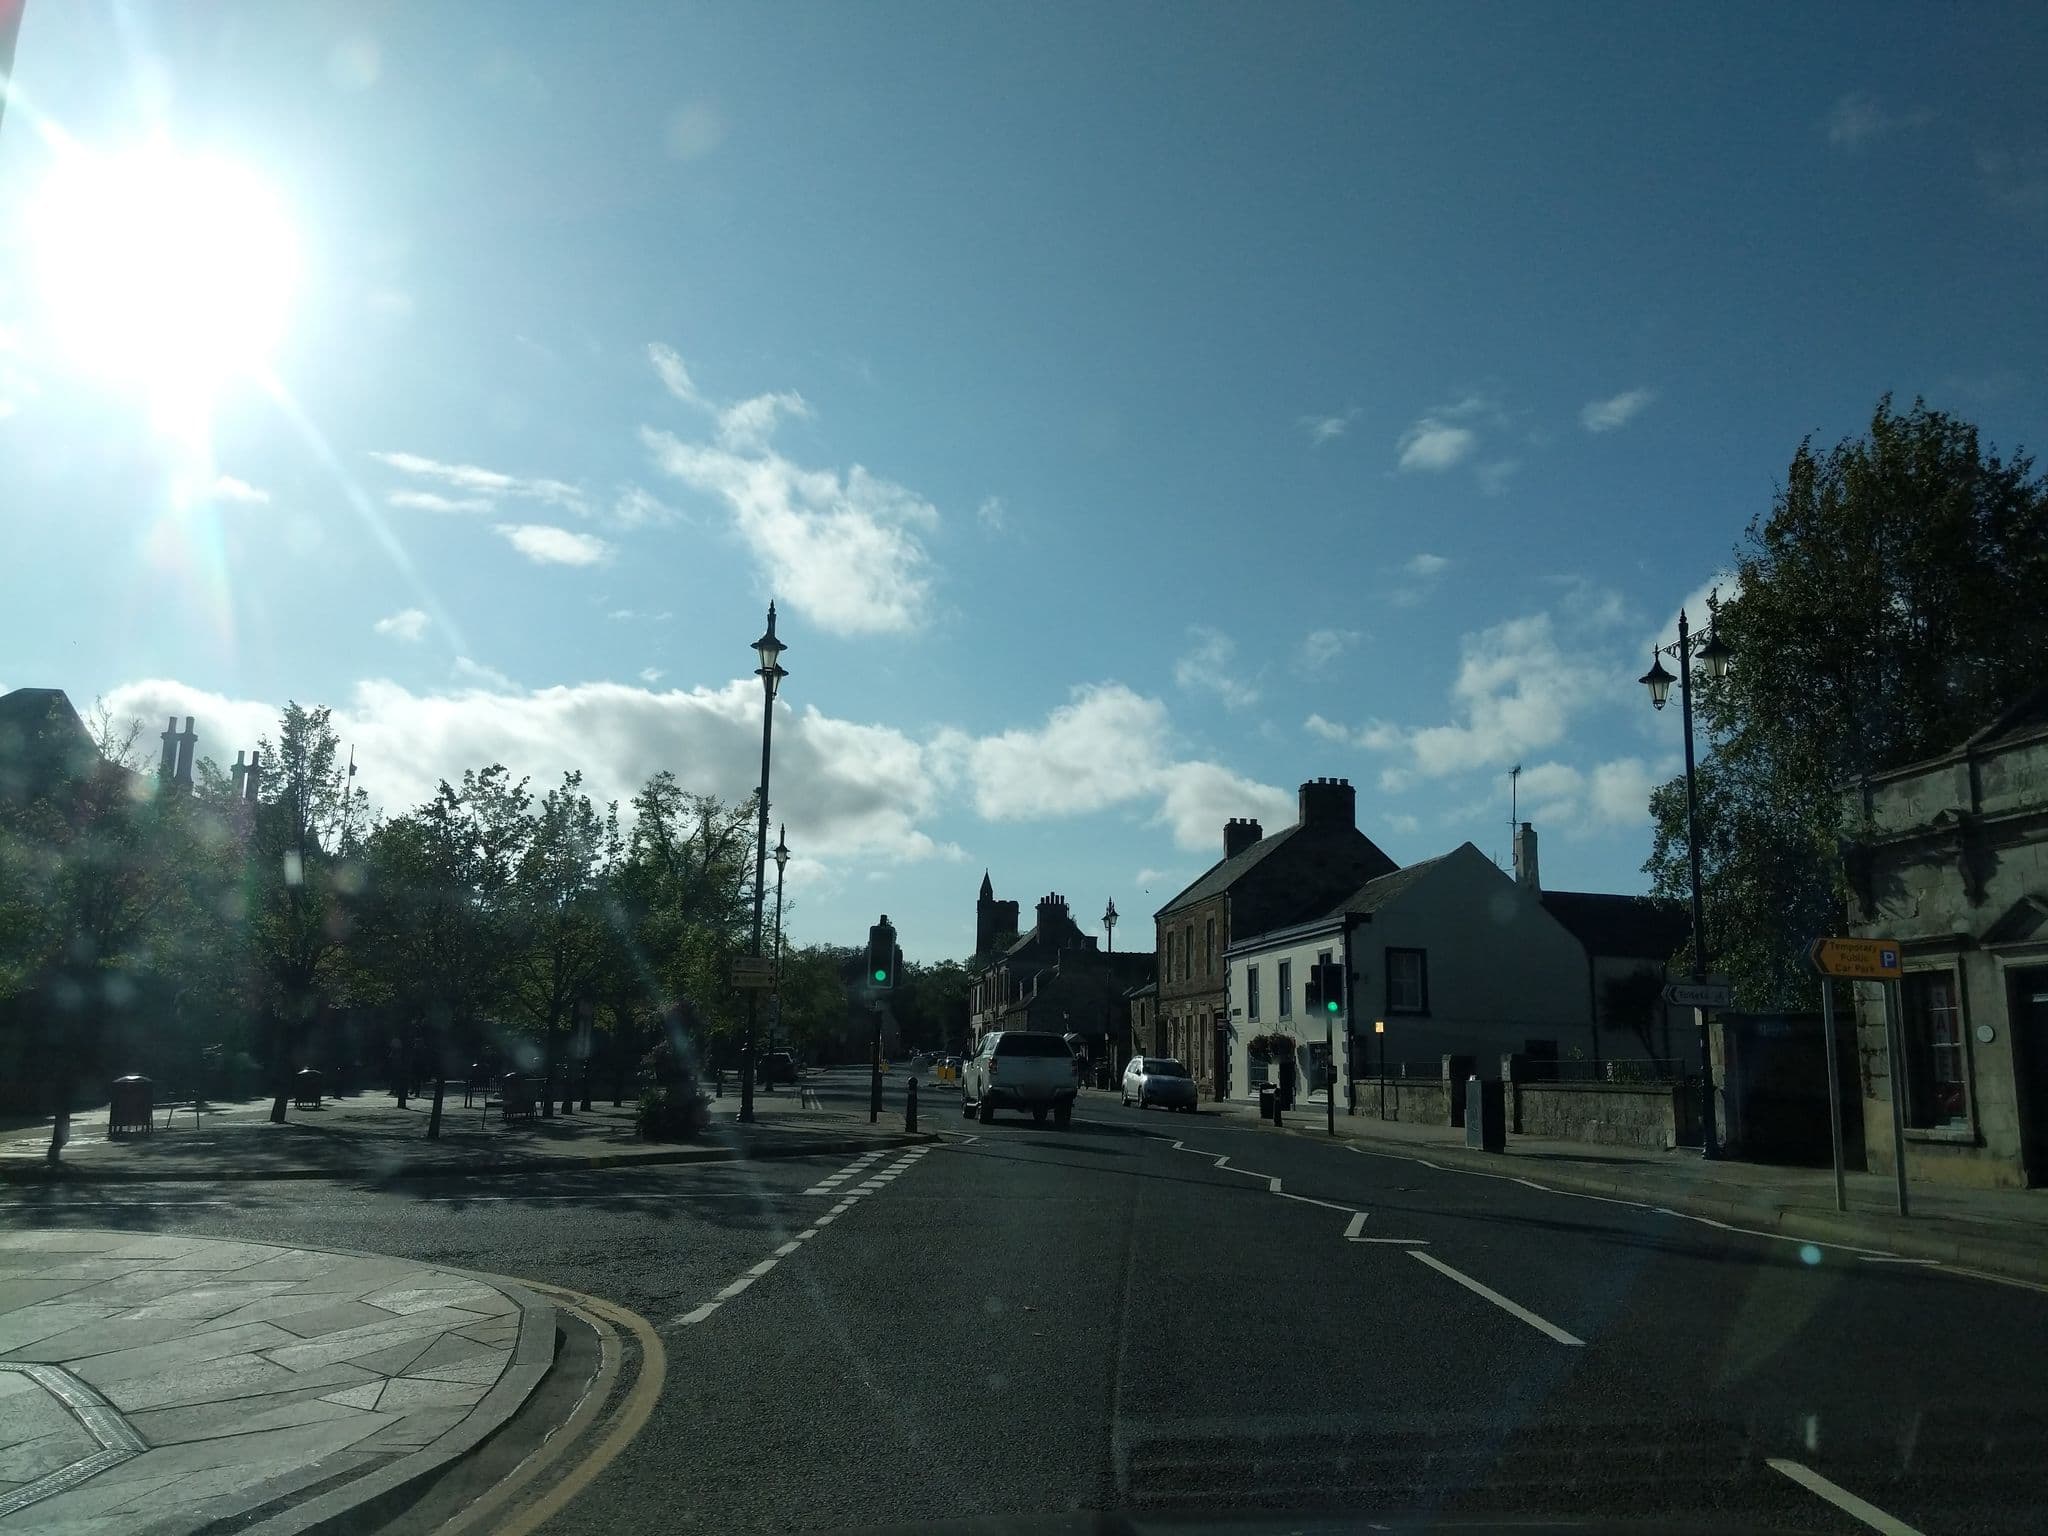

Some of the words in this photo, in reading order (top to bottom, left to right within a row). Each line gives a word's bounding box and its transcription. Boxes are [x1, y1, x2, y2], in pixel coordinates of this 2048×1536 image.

[1830, 941, 1878, 954] Temporary
[1883, 951, 1895, 967] P
[1835, 963, 1850, 972] Car
[1855, 964, 1875, 974] Park
